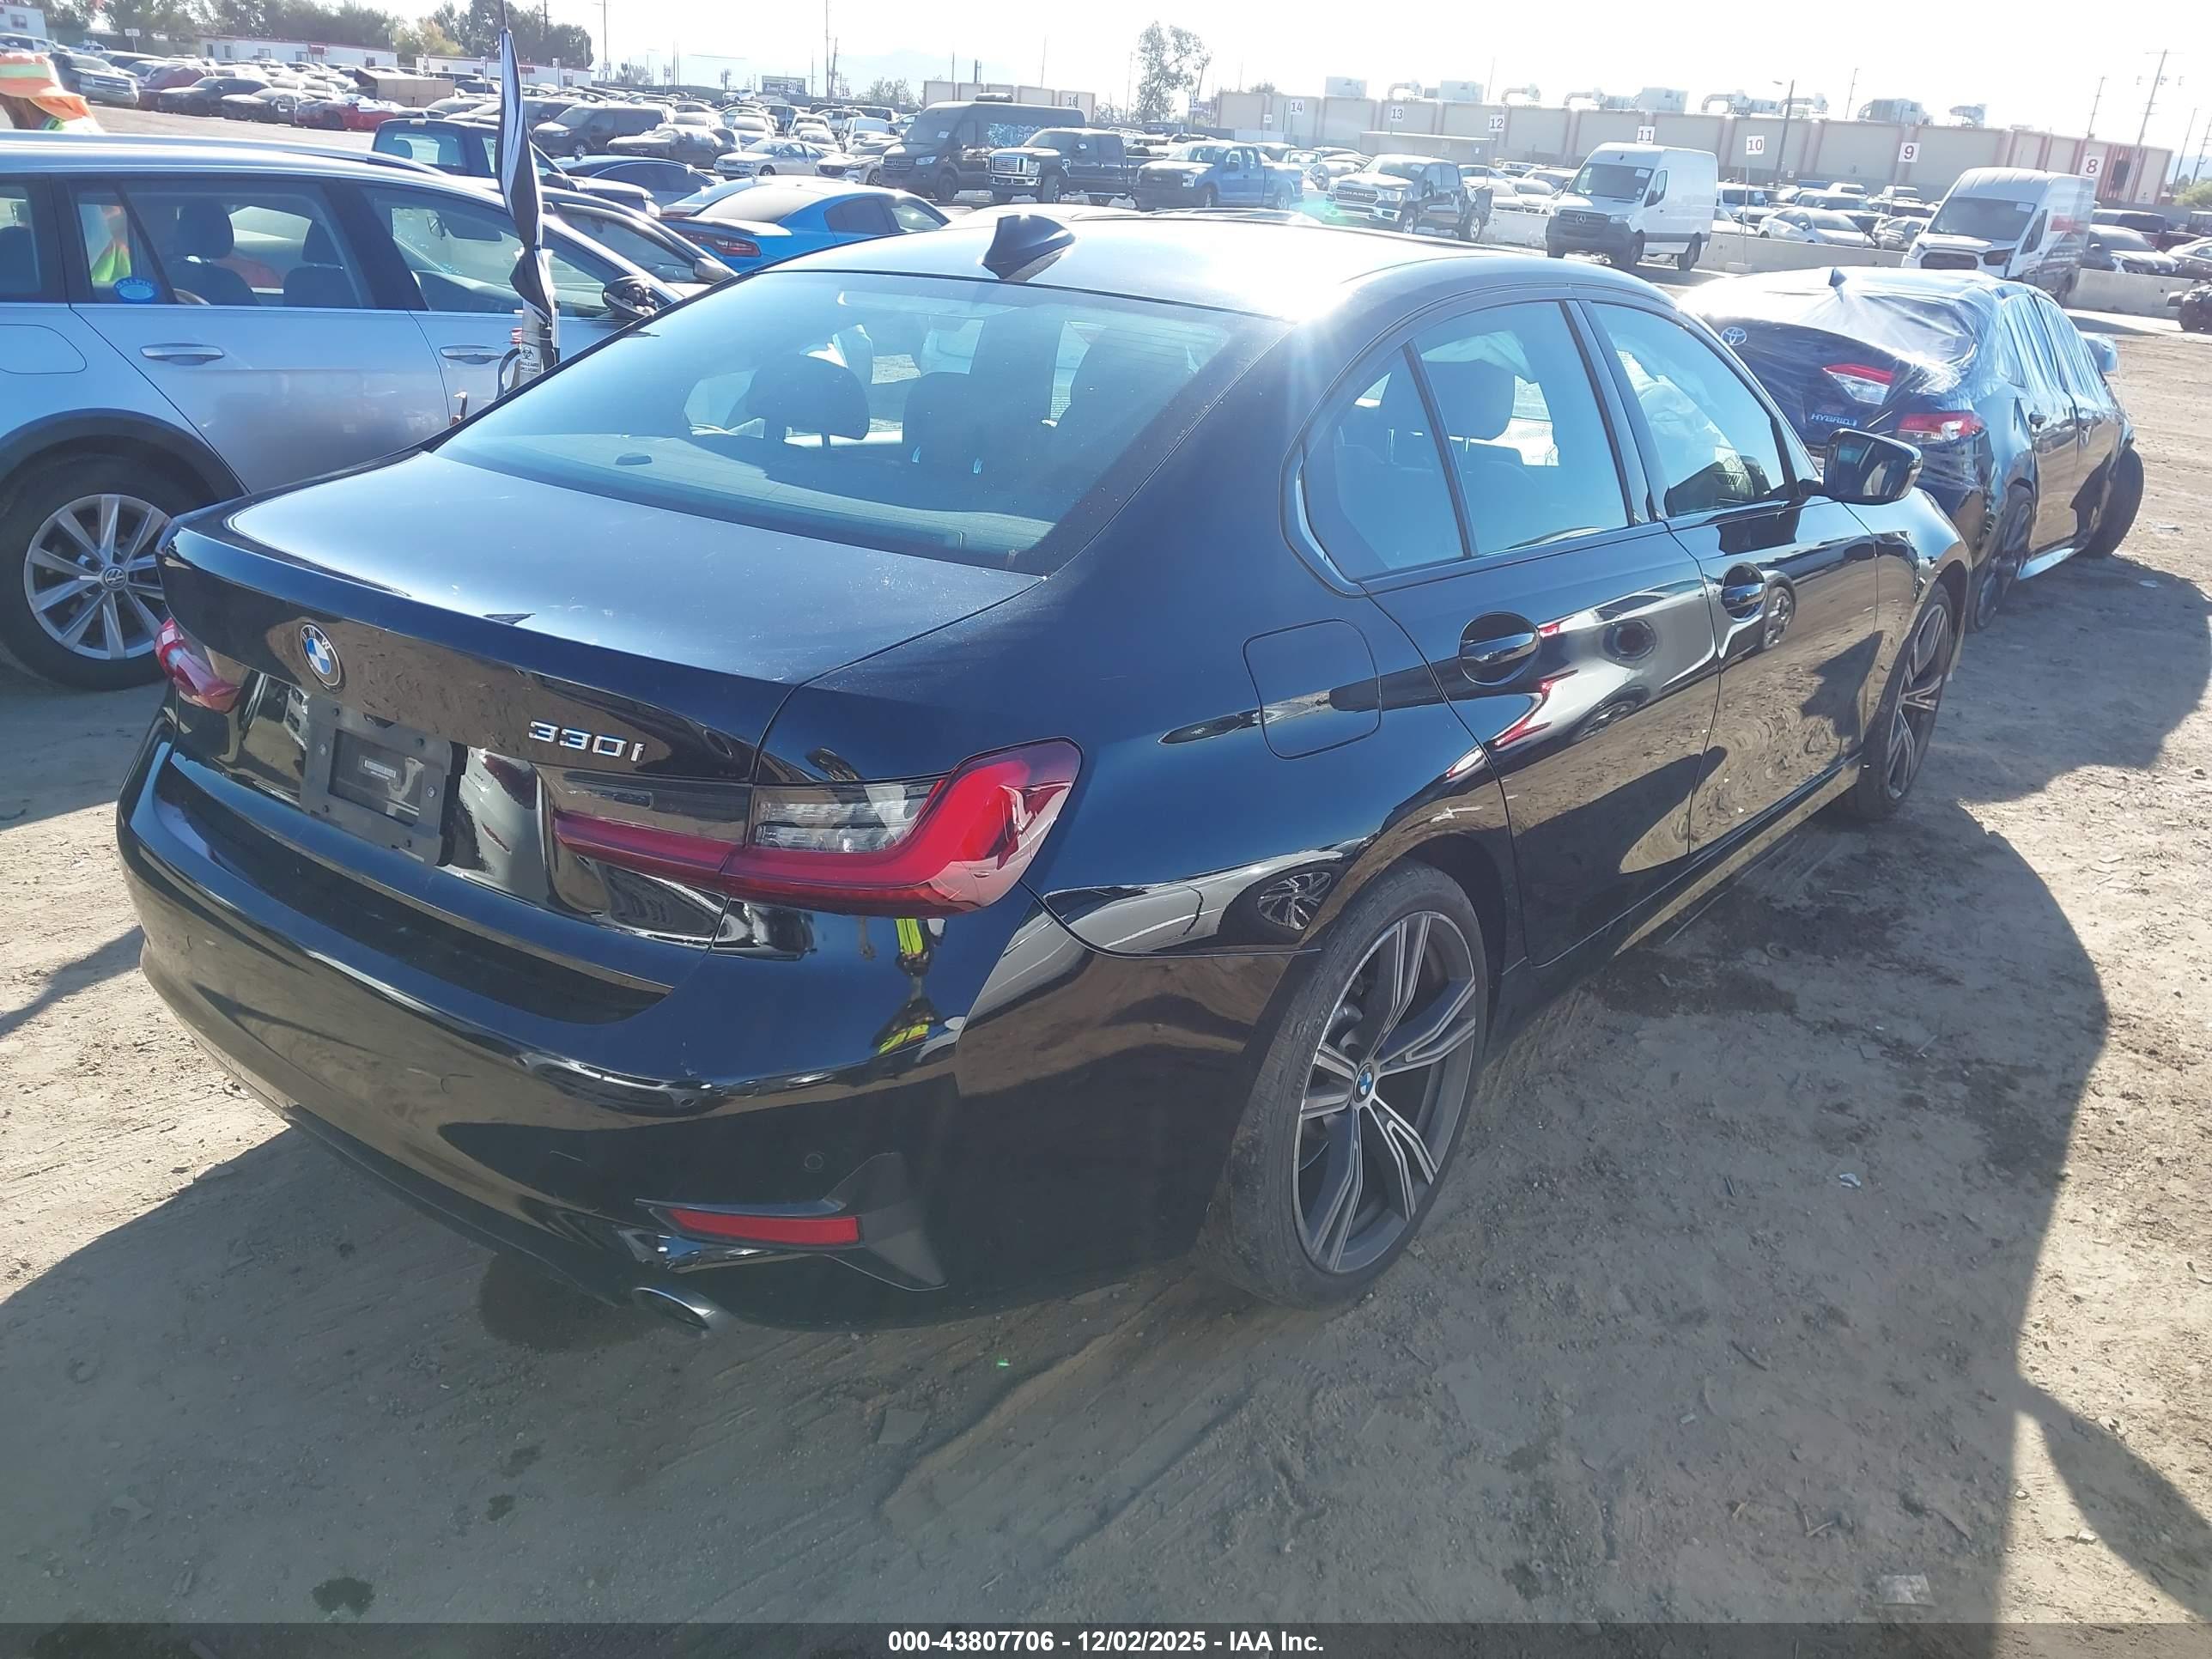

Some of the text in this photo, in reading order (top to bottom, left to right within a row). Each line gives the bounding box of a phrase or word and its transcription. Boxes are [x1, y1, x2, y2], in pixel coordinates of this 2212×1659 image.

[788, 82, 797, 90] 20
[841, 88, 850, 97] 19
[1188, 98, 1199, 108] 15
[1291, 102, 1303, 112] 14
[1391, 108, 1403, 119] 13
[1490, 118, 1504, 129] 12
[1638, 130, 1653, 142] 11
[1747, 139, 1763, 151] 10
[1904, 145, 1915, 160] 9
[2086, 159, 2099, 173] 8
[1811, 413, 1850, 426] HYBRID
[528, 720, 645, 763] 330i
